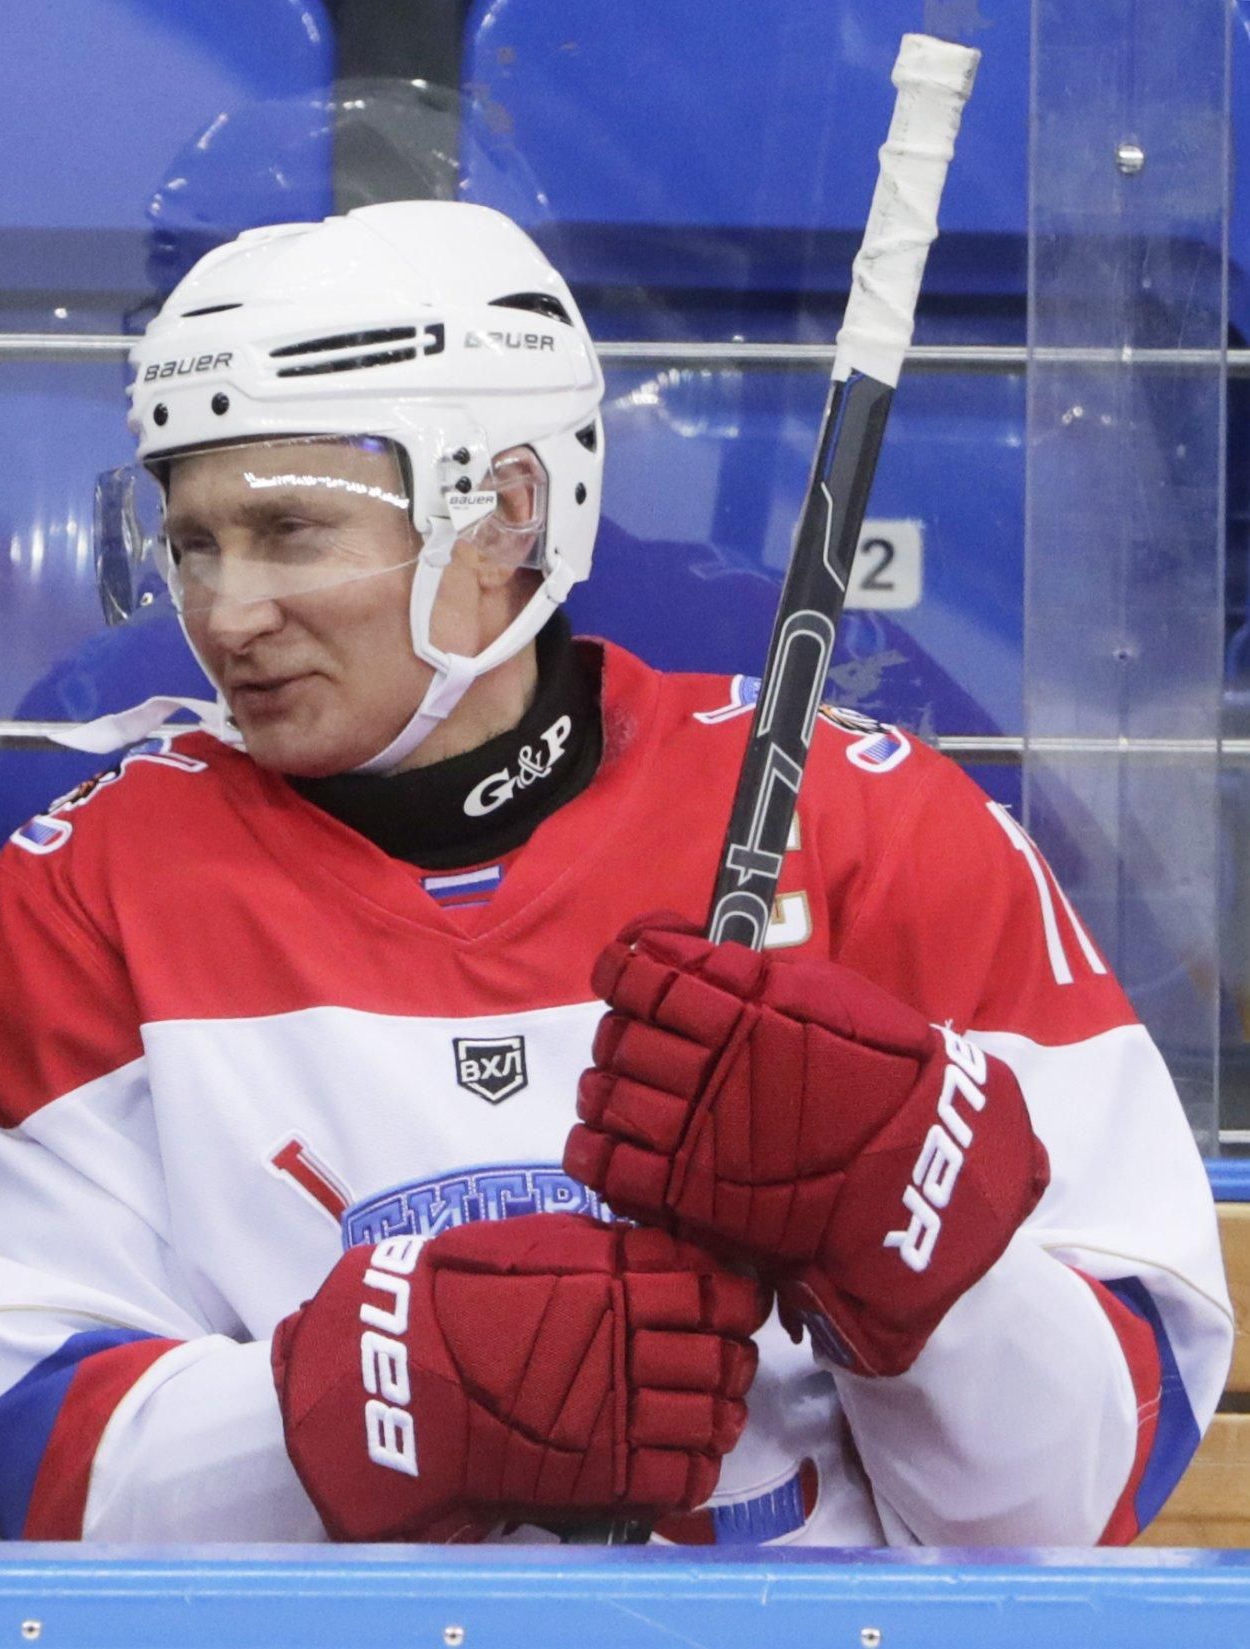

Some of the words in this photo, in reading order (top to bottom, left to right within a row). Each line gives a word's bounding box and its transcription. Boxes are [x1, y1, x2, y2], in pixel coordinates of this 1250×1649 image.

[859, 537, 895, 591] 2
[462, 714, 572, 818] G&P
[460, 1050, 522, 1082] ВХЛ
[882, 1019, 987, 1273] AUER
[350, 1171, 618, 1247] ТИГР
[359, 1234, 421, 1478] BAUE
